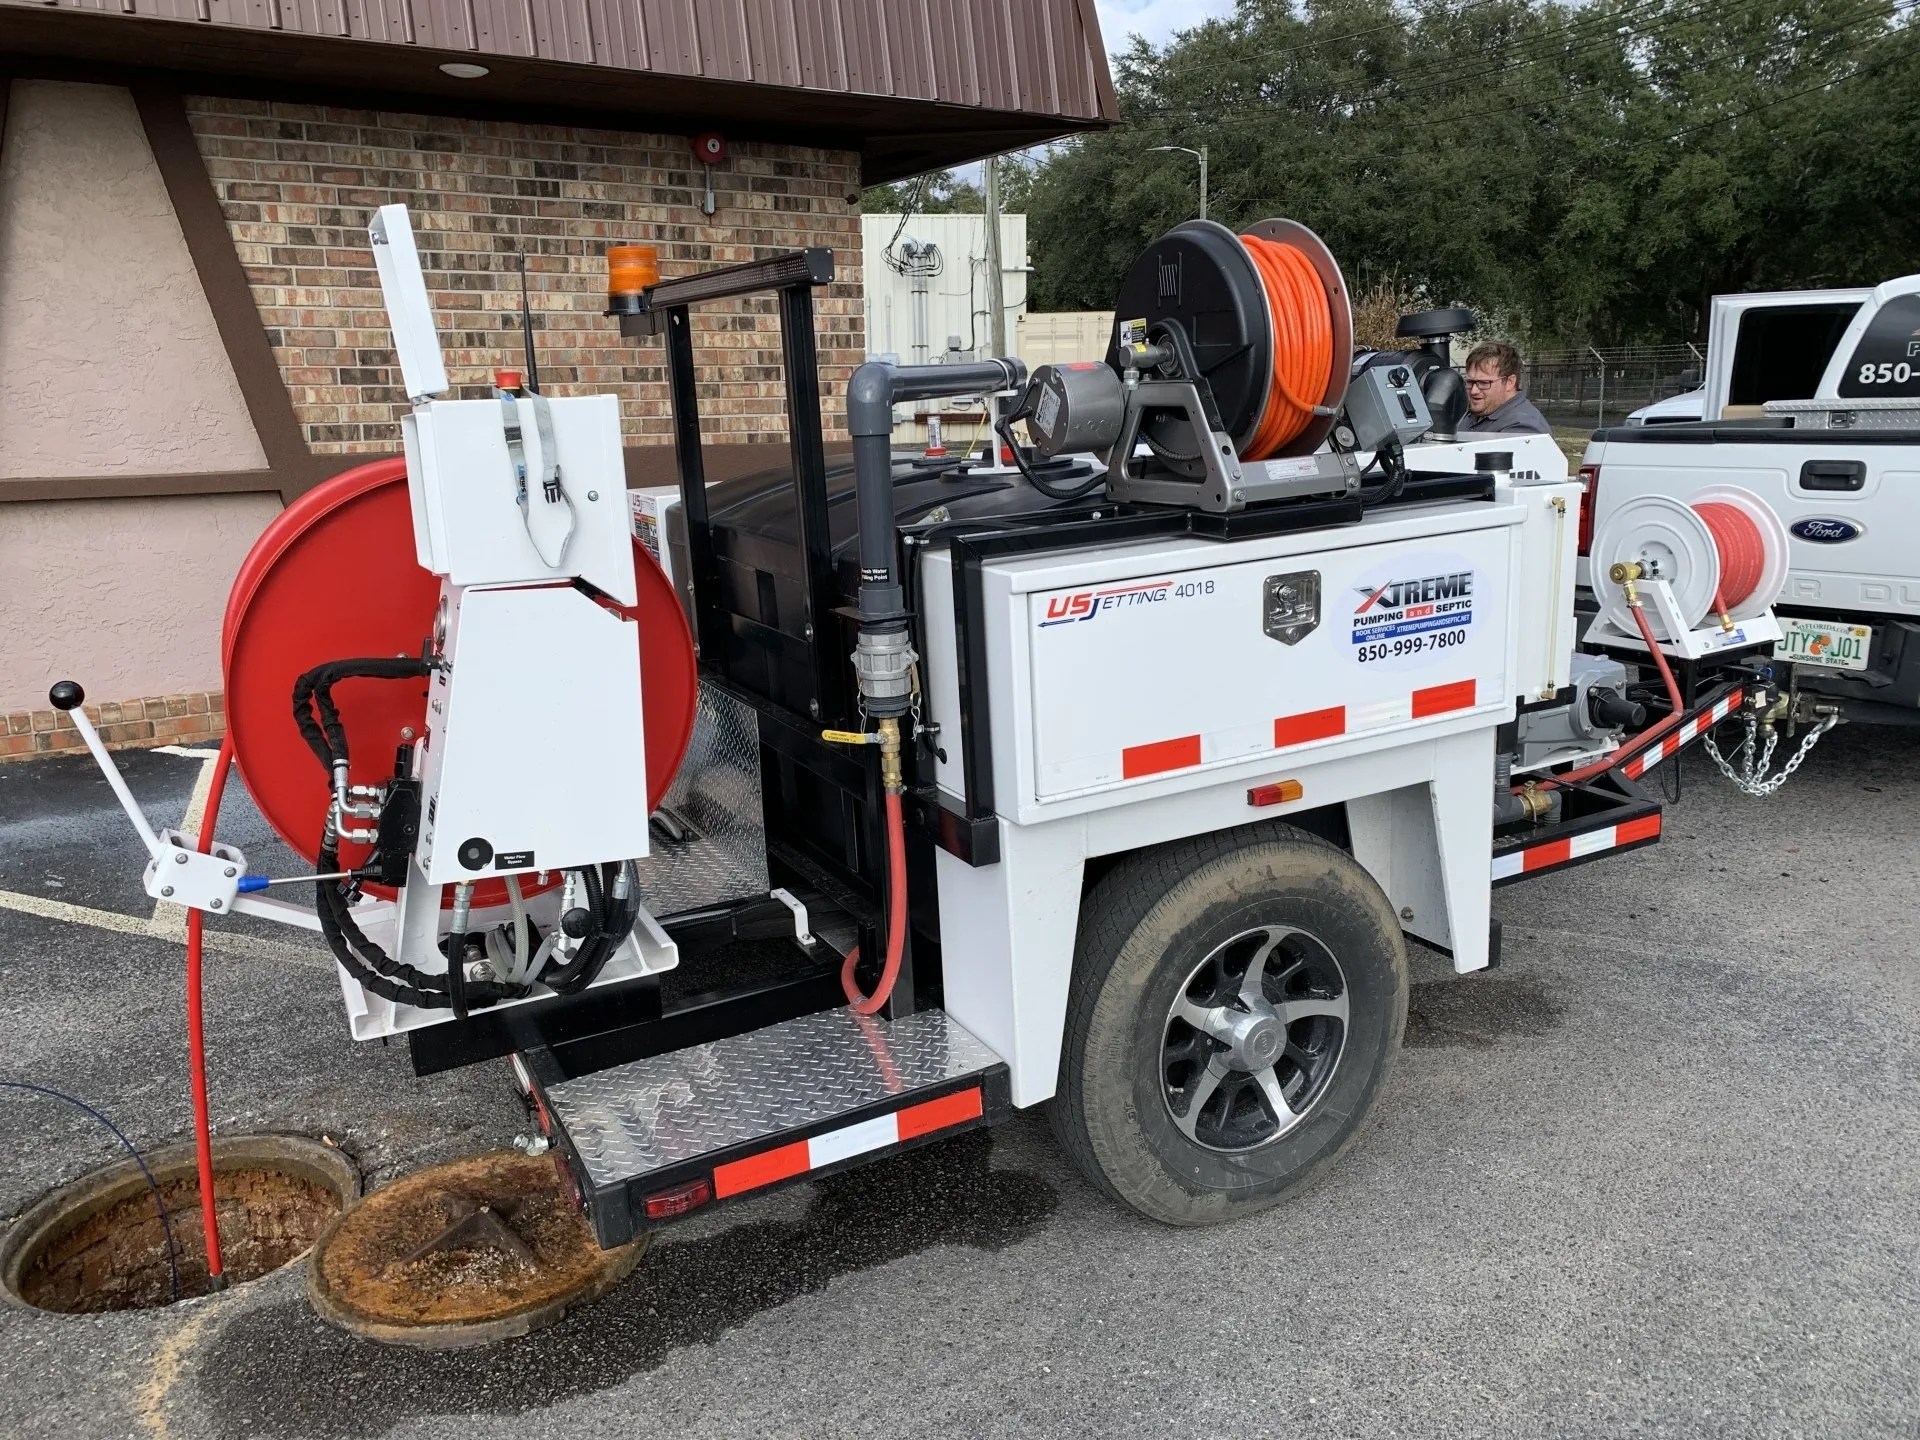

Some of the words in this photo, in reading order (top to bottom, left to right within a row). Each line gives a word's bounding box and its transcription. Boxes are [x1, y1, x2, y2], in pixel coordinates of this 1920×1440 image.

[1803, 520, 1845, 538] Ford
[1175, 580, 1215, 598] 4018
[1353, 570, 1474, 614] XTREME
[1353, 611, 1404, 628] PUMPING
[1409, 608, 1431, 617] and
[1435, 599, 1472, 614] SEPTIC
[1355, 628, 1371, 636] BOOK
[1371, 624, 1396, 634] SERVICES
[1365, 633, 1386, 641] ONLINE
[1358, 629, 1466, 663] 850-999-7800
[1777, 631, 1811, 654] JTY
[1792, 653, 1823, 663] SUNSHINE
[1825, 657, 1846, 666] STATE
